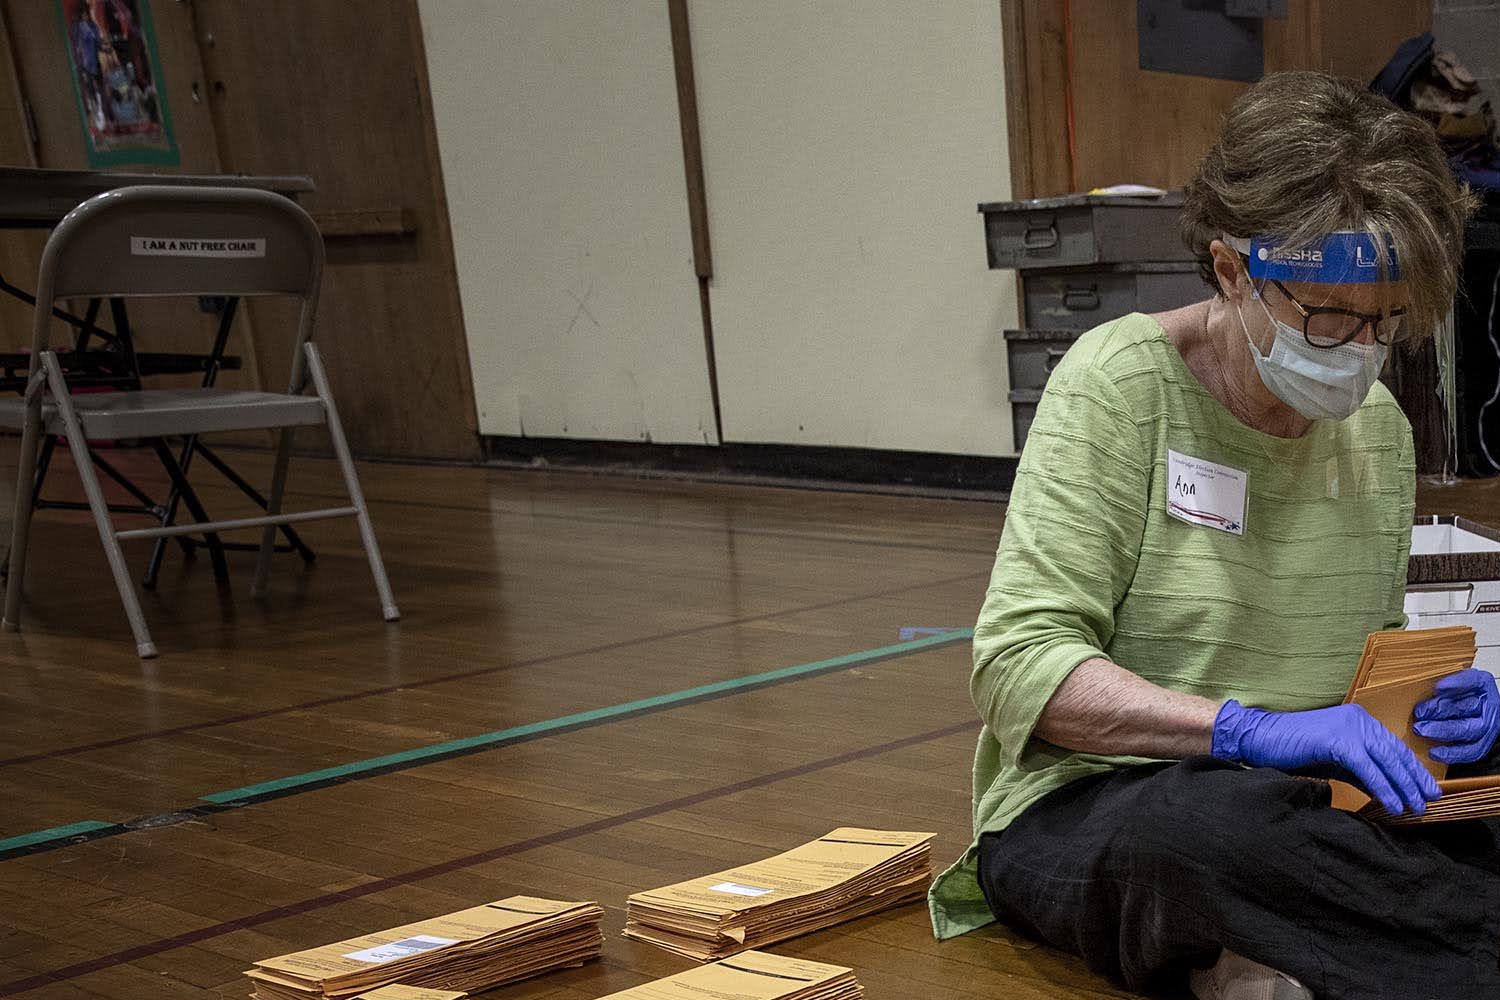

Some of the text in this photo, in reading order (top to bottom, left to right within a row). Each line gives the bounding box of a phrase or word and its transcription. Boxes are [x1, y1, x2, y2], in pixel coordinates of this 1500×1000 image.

[149, 241, 166, 250] AM
[168, 241, 177, 250] A
[179, 241, 199, 251] NUT
[200, 242, 226, 251] FREE
[228, 242, 257, 251] CHAIR
[1175, 474, 1196, 497] Ann
